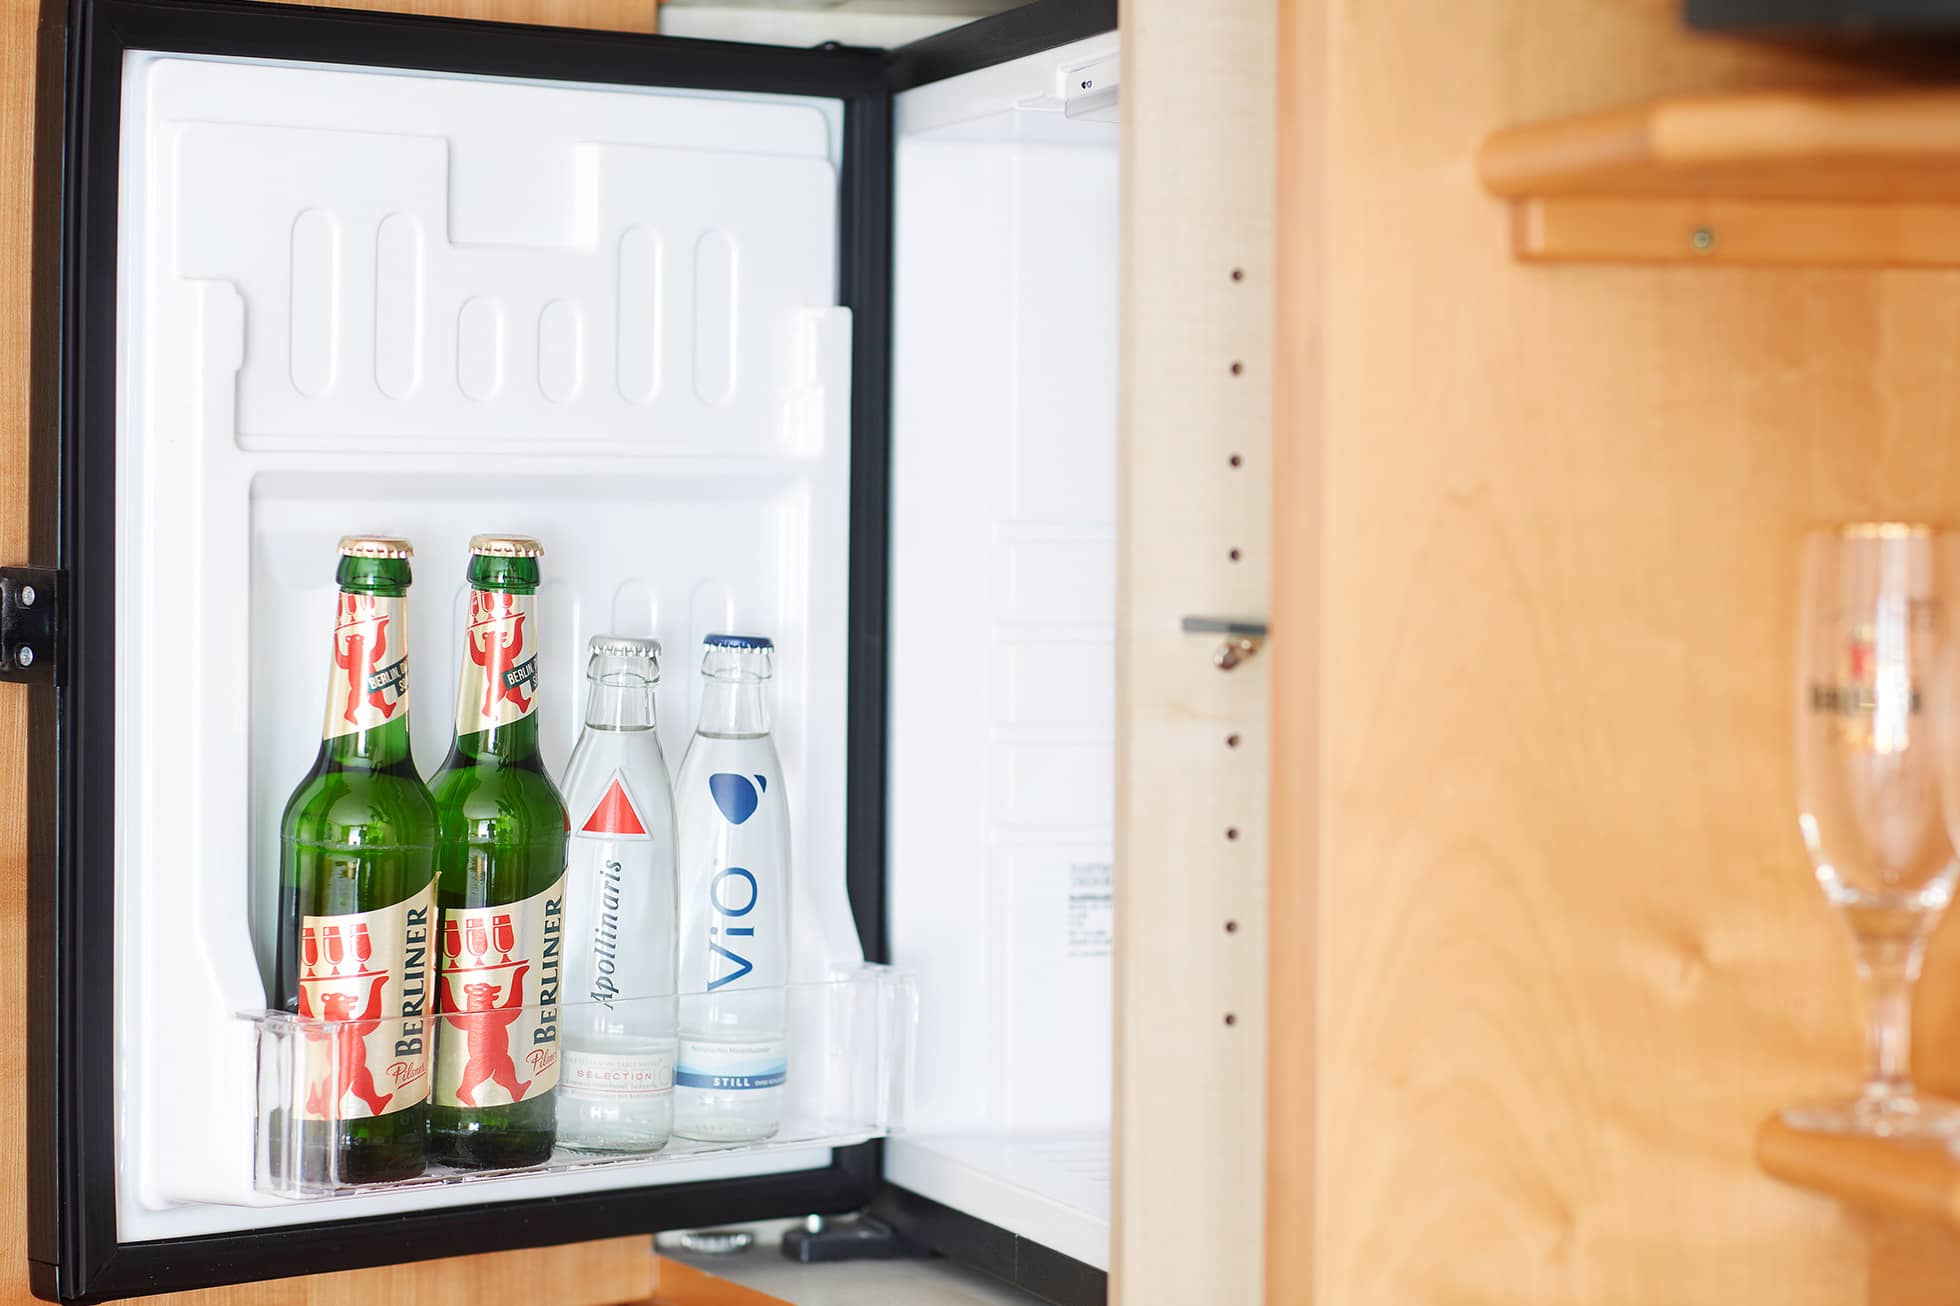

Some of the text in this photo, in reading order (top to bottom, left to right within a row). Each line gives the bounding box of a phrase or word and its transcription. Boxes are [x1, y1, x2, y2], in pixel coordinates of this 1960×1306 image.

[394, 903, 429, 1058] BERLINER
[533, 895, 563, 1045] BERLINER
[590, 859, 622, 1011] Apollinaris
[576, 1069, 654, 1082] SELECTION
[713, 1077, 751, 1087] STILL
